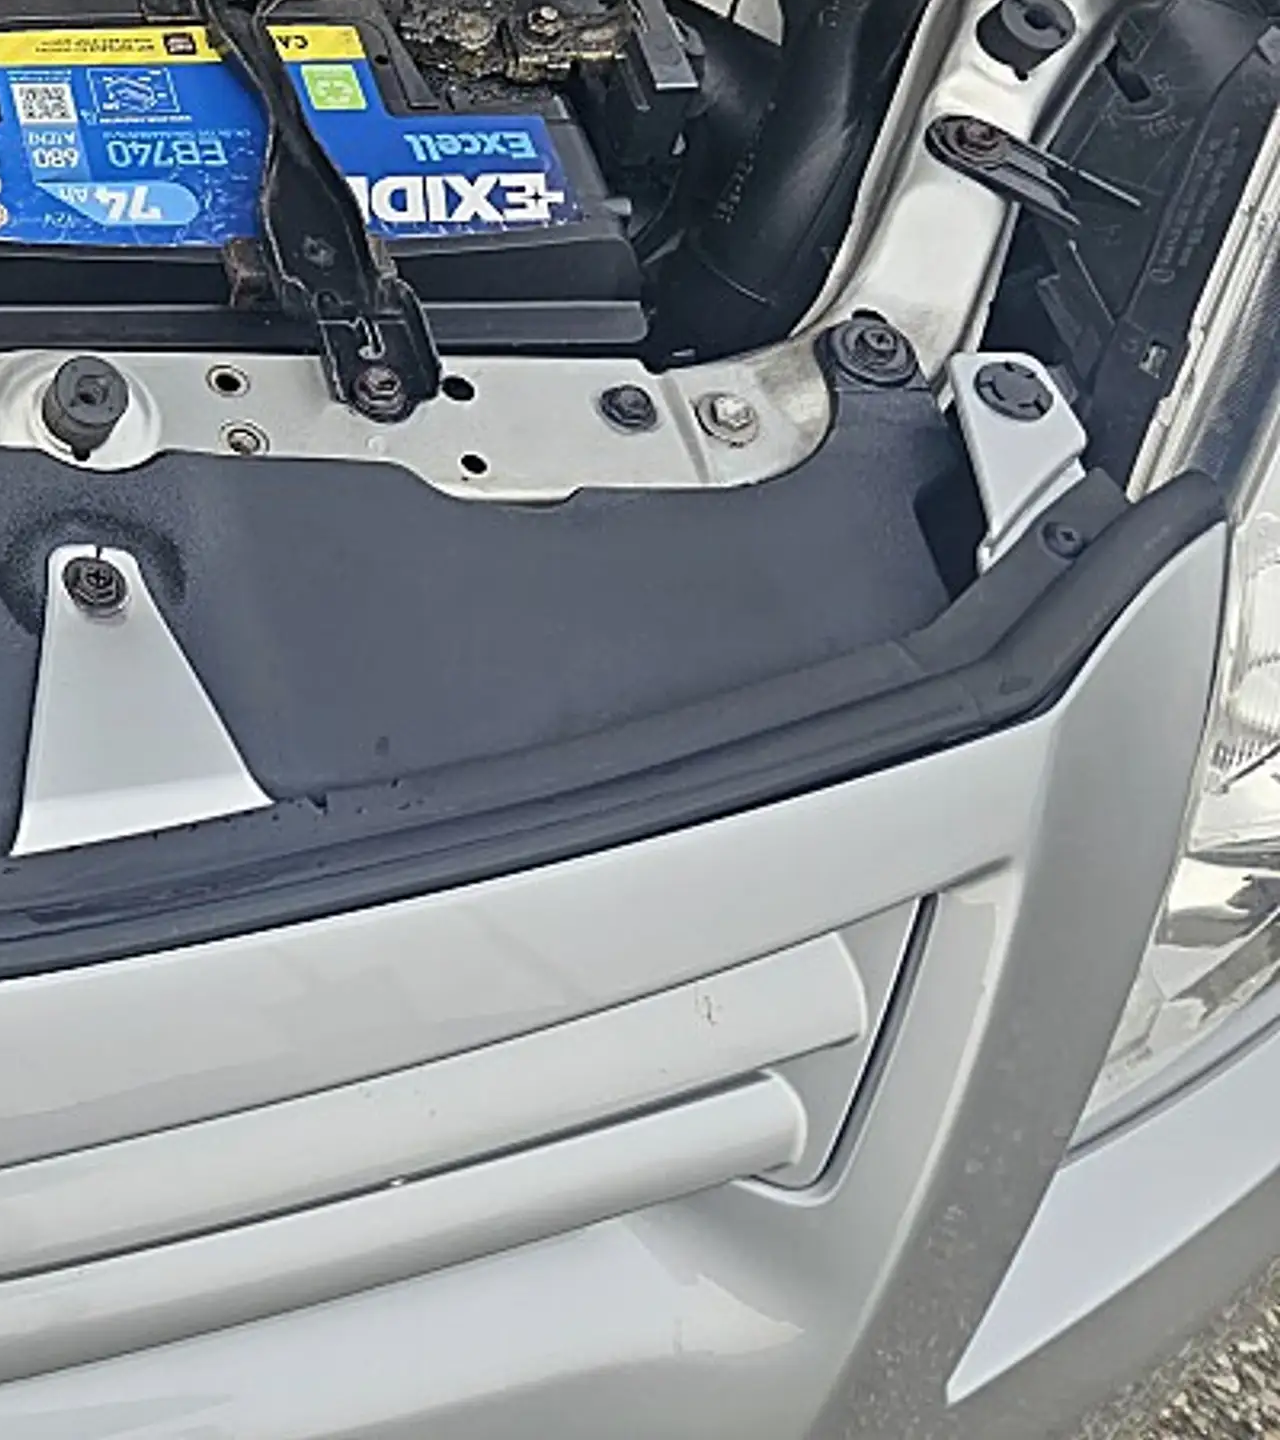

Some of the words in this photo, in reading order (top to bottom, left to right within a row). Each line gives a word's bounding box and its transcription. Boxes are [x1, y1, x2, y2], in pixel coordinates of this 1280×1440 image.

[34, 148, 79, 168] 680
[106, 138, 227, 168] EB740
[403, 130, 536, 163] Excell
[95, 185, 162, 222] 74
